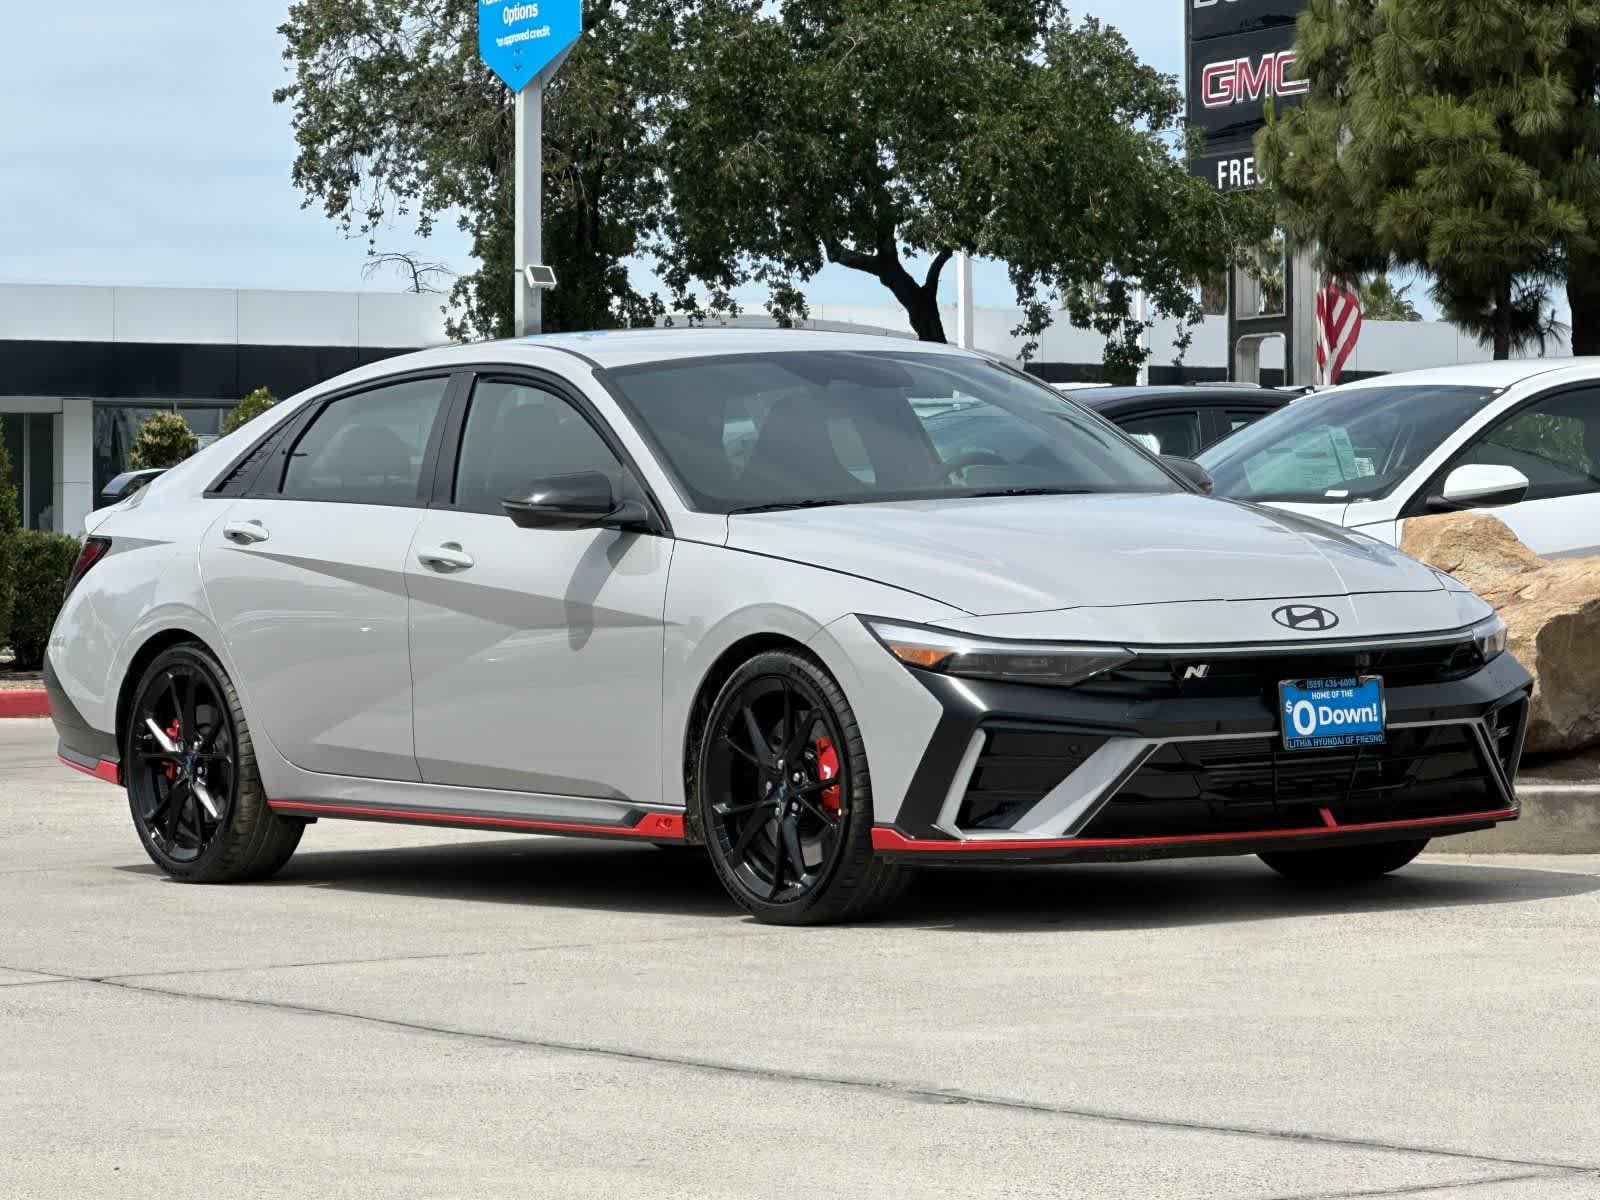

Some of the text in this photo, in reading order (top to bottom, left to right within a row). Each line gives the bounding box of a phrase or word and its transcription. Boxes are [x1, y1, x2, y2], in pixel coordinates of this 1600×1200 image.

[503, 3, 538, 26] Options
[530, 25, 551, 38] credit
[1202, 51, 1310, 106] GMC
[1311, 689, 1354, 700] HOME OF THE
[1318, 703, 1378, 726] Down!
[1313, 737, 1345, 747] HYUNDAI
[1345, 735, 1354, 744] OF
[1356, 734, 1383, 744] FRESNO
